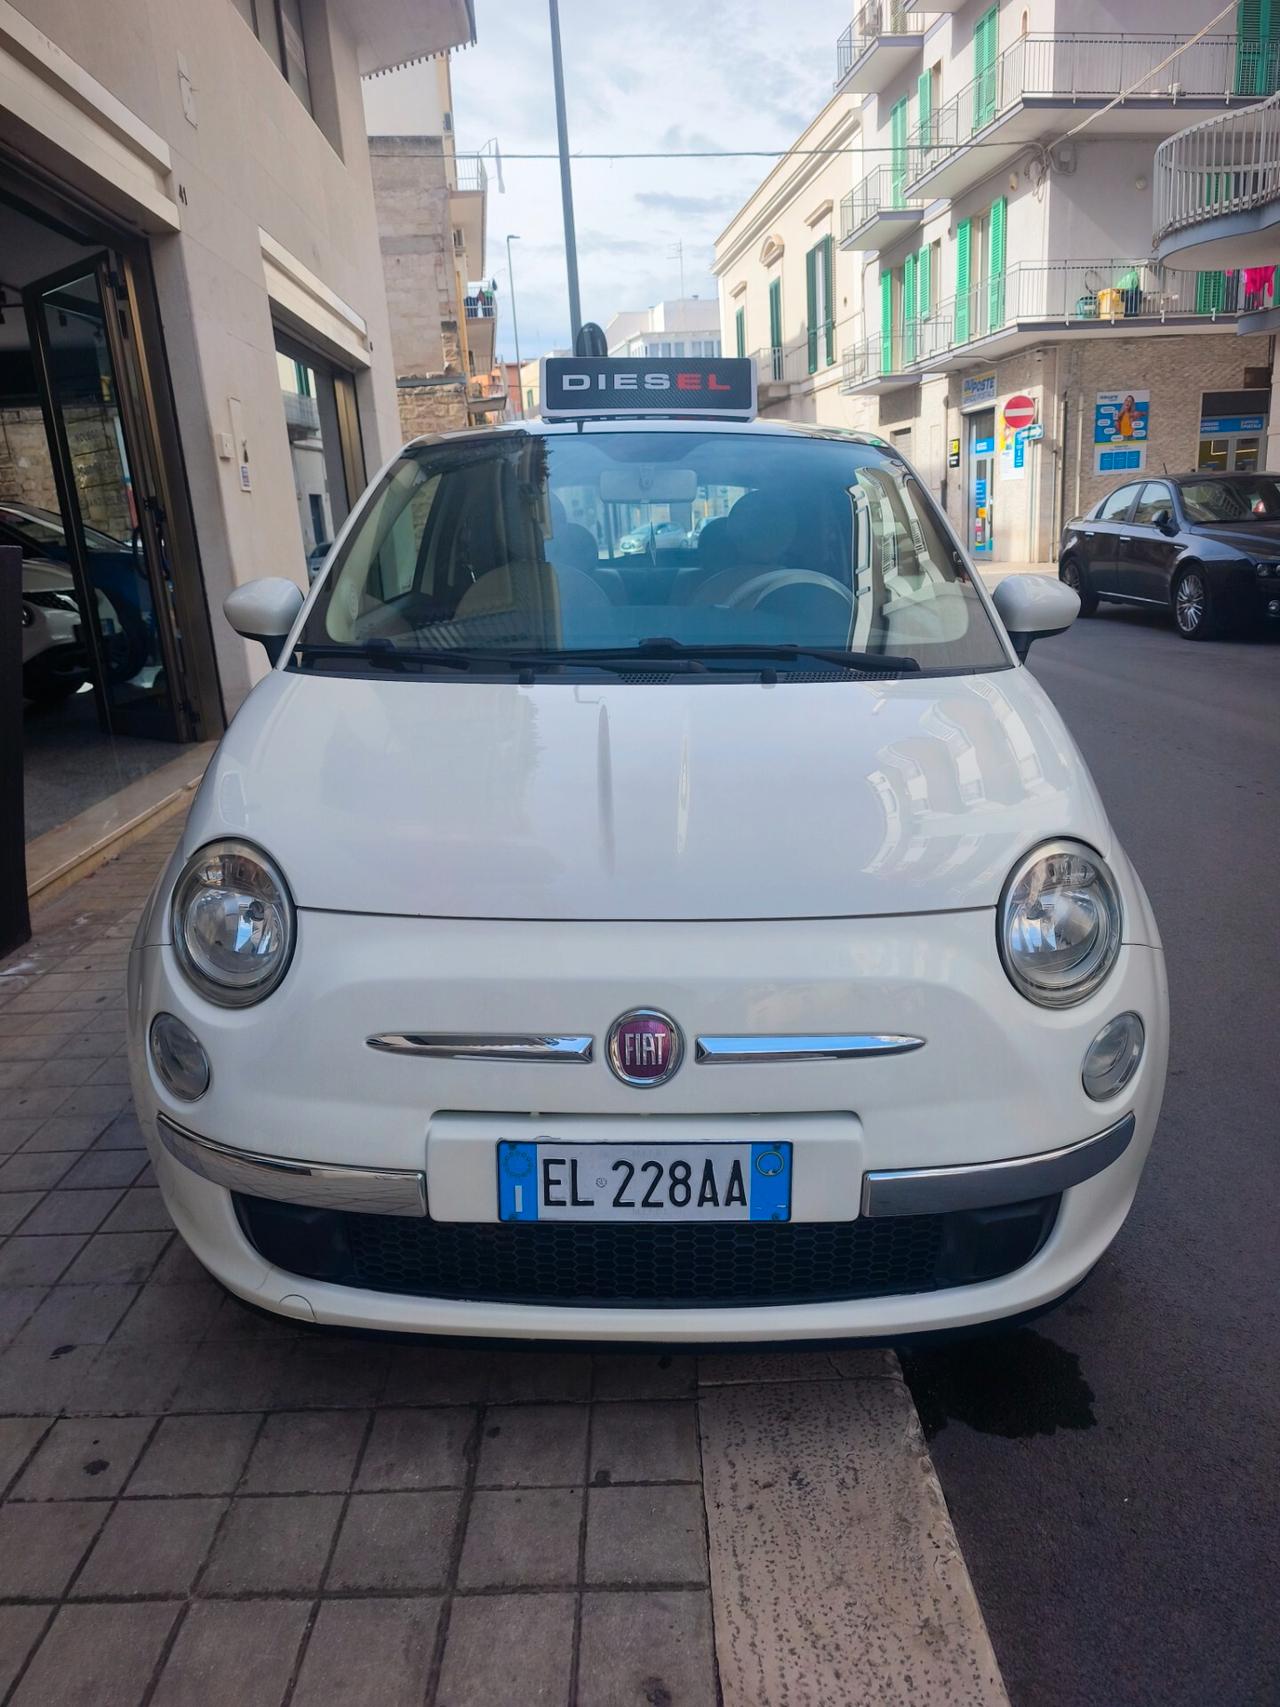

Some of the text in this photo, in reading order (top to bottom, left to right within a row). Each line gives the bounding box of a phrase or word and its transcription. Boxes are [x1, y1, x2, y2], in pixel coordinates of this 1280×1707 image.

[561, 373, 731, 391] DIESEL
[624, 1032, 666, 1066] FIAT
[543, 1158, 748, 1207] EL 228AA
